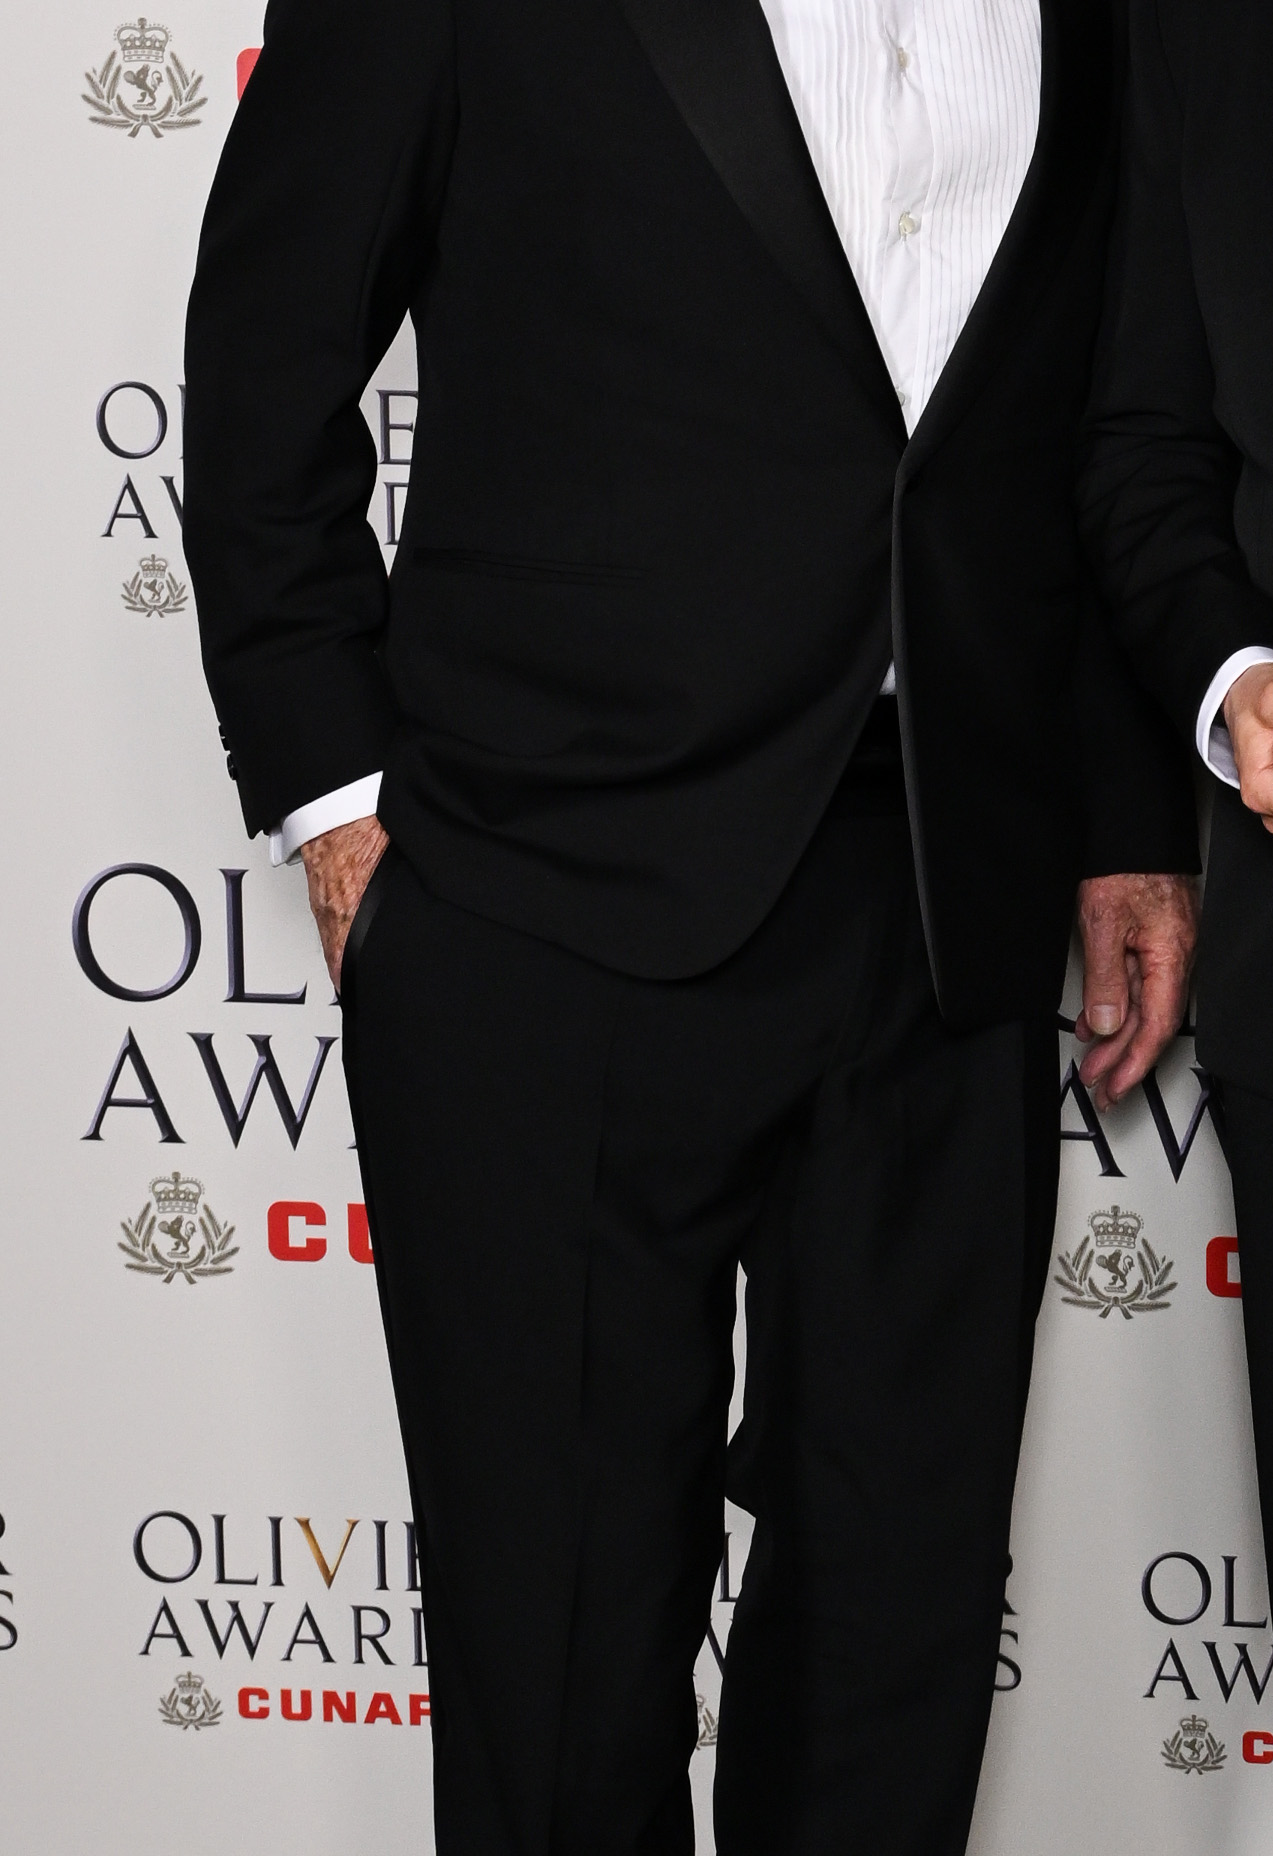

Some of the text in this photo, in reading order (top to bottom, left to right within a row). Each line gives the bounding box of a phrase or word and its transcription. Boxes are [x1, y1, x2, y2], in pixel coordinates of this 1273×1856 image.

[132, 1509, 422, 1591] OLIVI
[138, 1595, 429, 1667] AWAR
[237, 1686, 432, 1726] CUNAR
